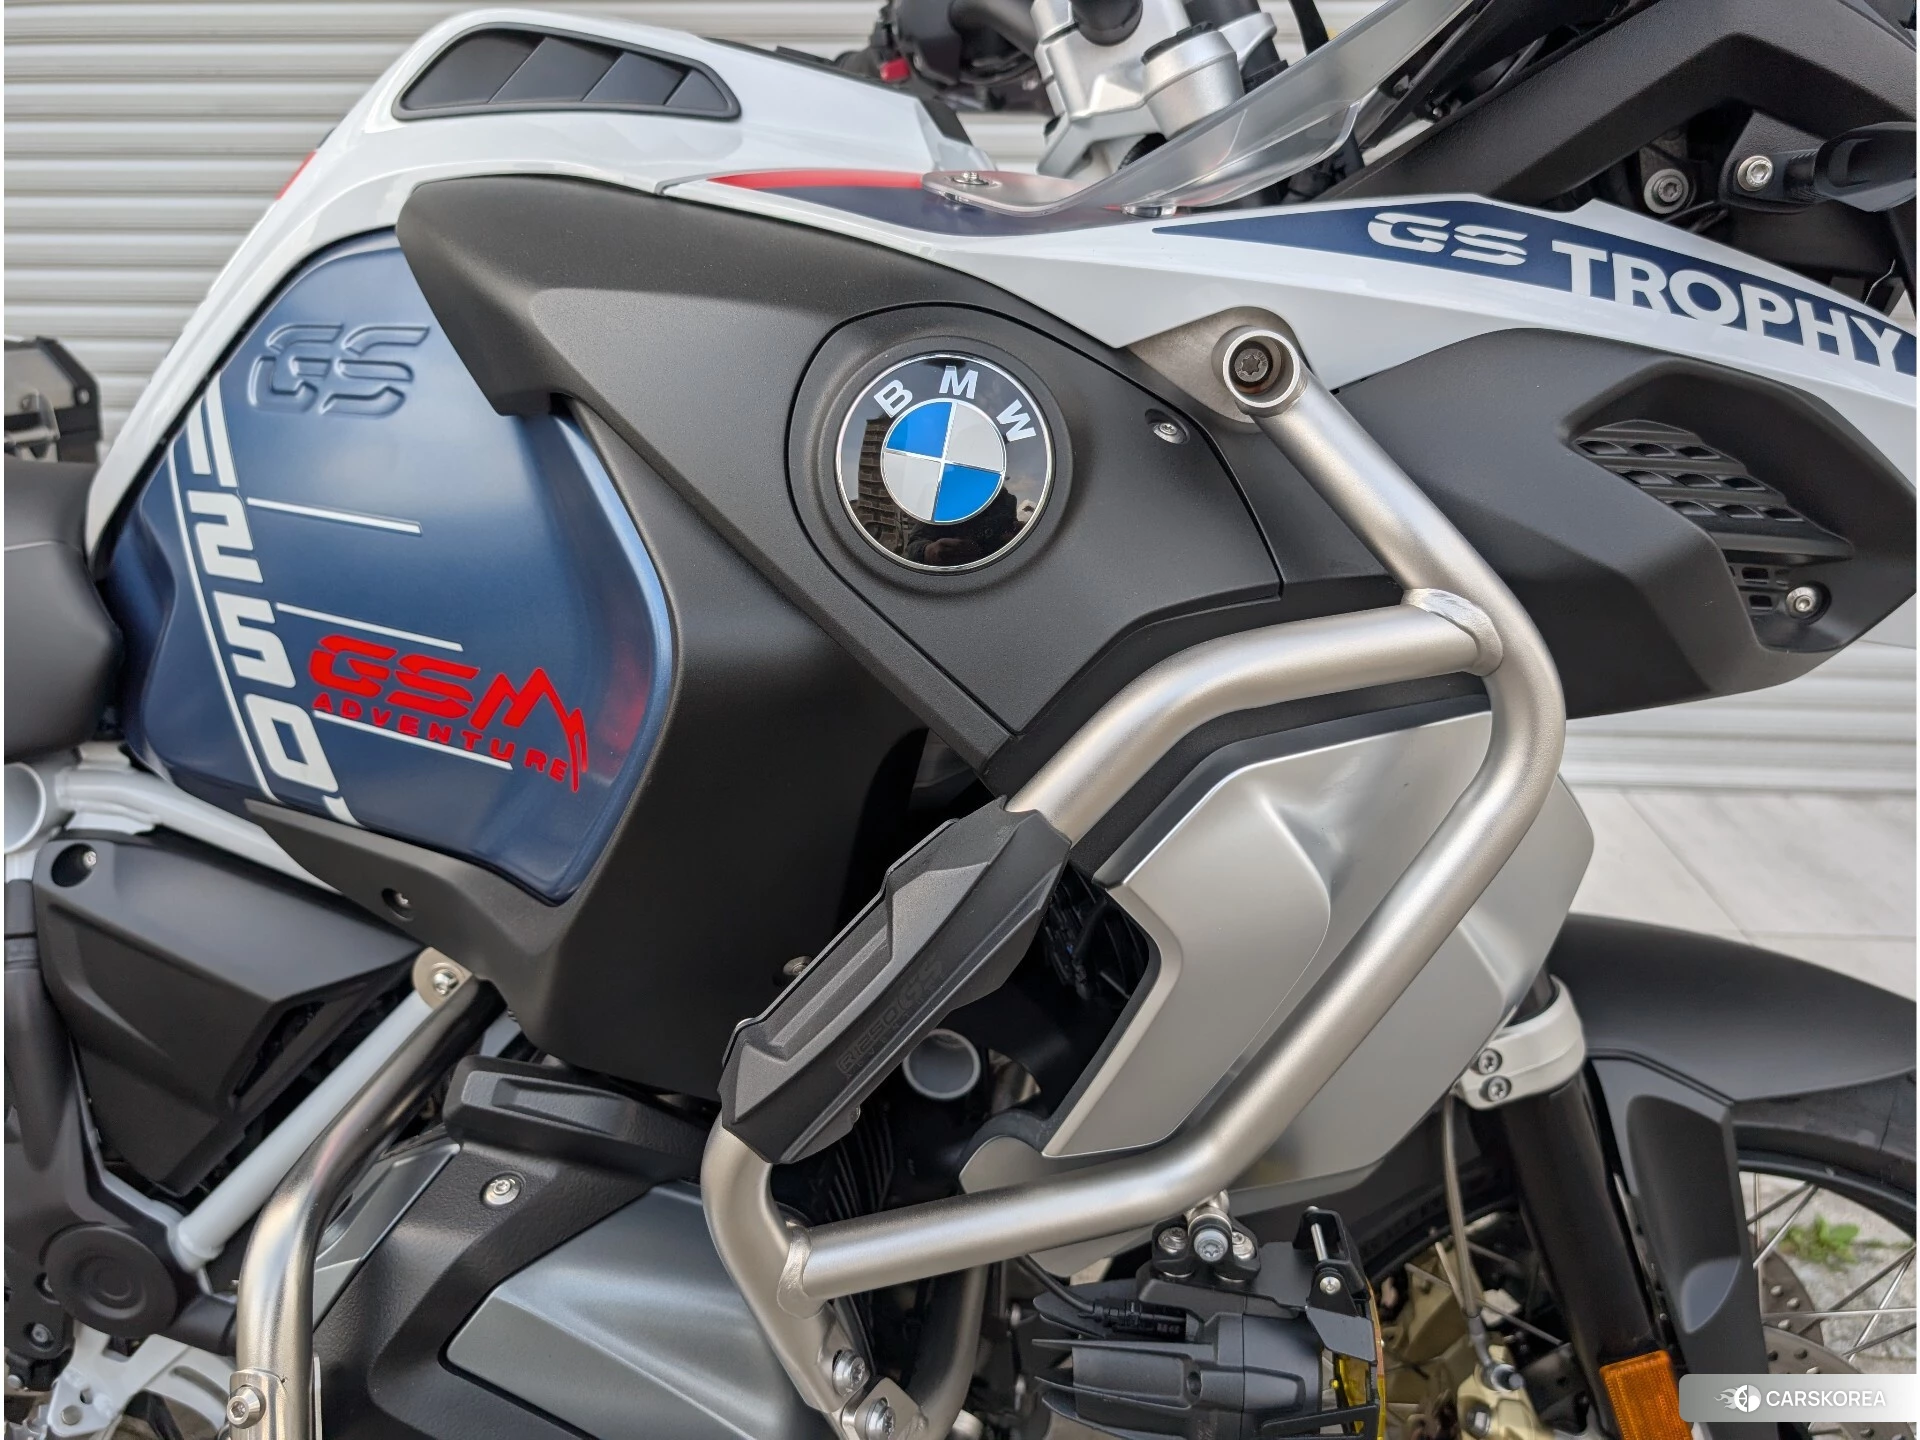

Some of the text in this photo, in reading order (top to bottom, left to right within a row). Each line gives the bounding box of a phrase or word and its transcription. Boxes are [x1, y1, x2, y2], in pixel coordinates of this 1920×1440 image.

[1367, 212, 1902, 374] GS TROPHY
[247, 322, 430, 420] GS
[873, 365, 1037, 442] BMW
[312, 692, 570, 781] ADVENTURE
